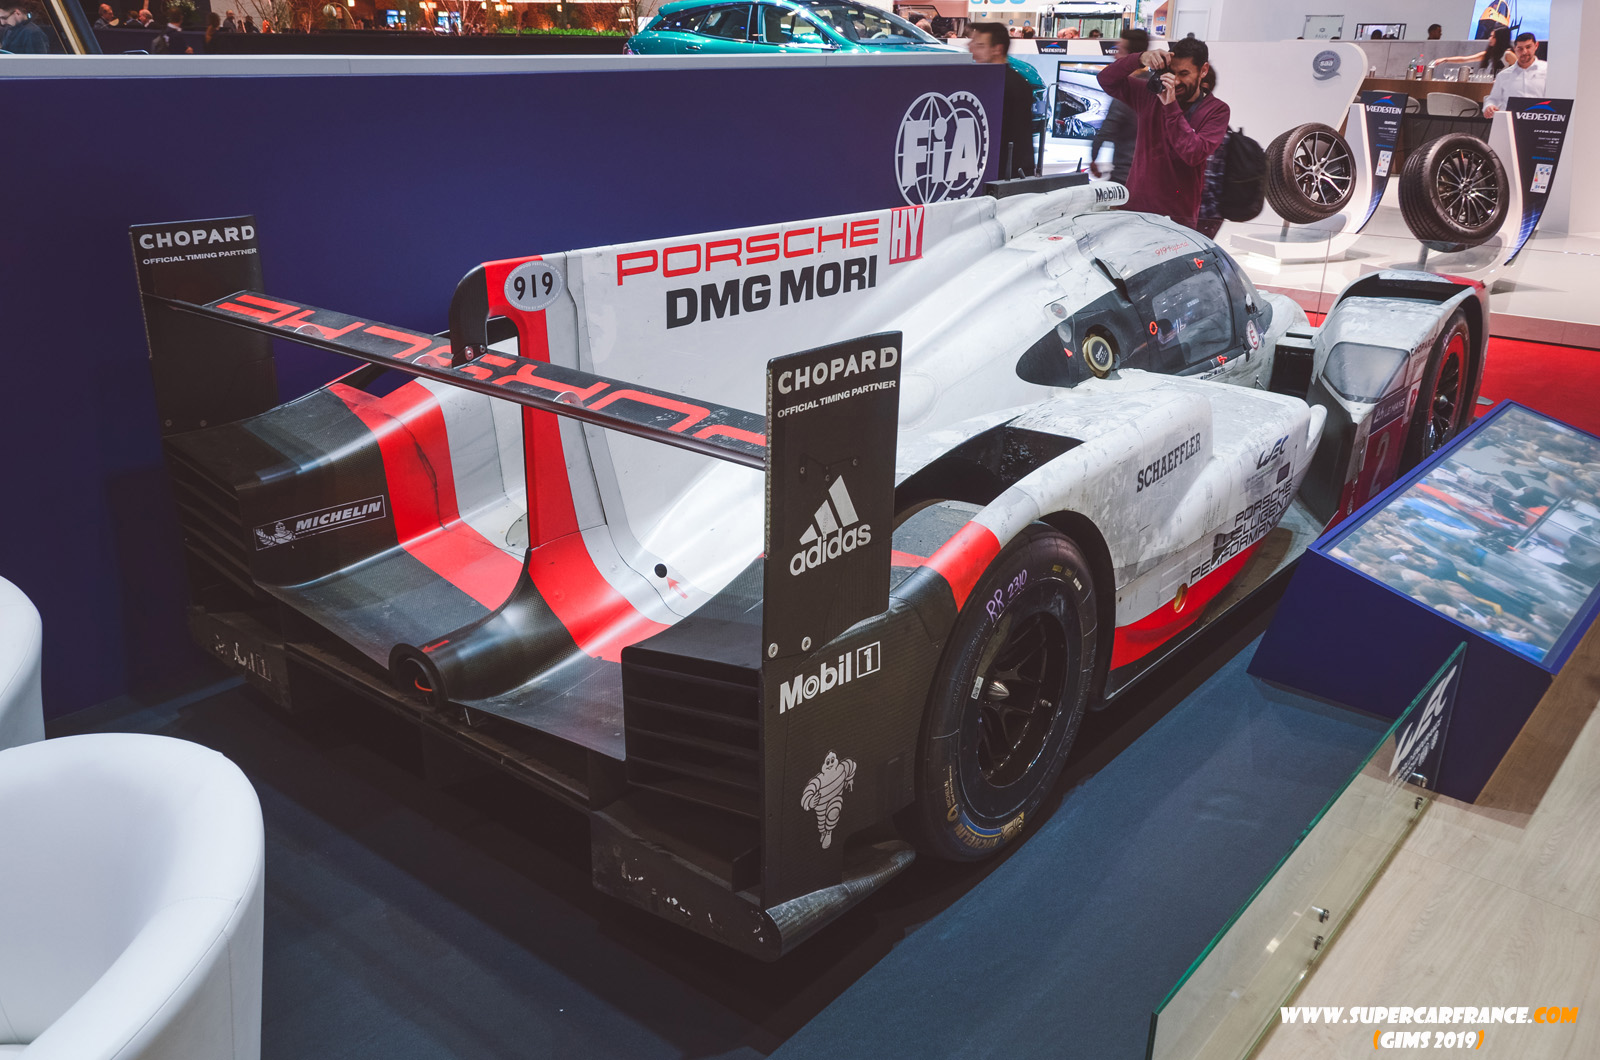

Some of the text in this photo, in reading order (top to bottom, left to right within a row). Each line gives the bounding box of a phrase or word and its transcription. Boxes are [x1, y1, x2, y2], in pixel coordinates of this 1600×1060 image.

[1366, 104, 1402, 114] VREDESTEIN
[1515, 111, 1566, 122] VREDESTEIN
[1095, 187, 1117, 203] Mobil
[139, 225, 256, 250] CHOPARD
[142, 247, 257, 265] OFFICIAL TIMING PARTNER
[617, 218, 880, 286] PORSCHE
[891, 207, 924, 261] HY
[513, 271, 554, 301] 919
[666, 255, 878, 330] DMG MORI
[777, 346, 898, 395] CHOPARD
[777, 380, 896, 418] OFFICIAL TIMING PARTNER
[1137, 432, 1201, 493] SCHAEFFLER
[1368, 431, 1390, 498] 2
[295, 501, 382, 531] MICHELIN
[1234, 478, 1293, 527] PORSCHE
[789, 524, 872, 576] adidas
[986, 569, 1028, 623] RR 2310
[780, 651, 852, 715] Mobil
[1388, 664, 1458, 777] WEC
[954, 822, 1002, 850] MICHELIN
